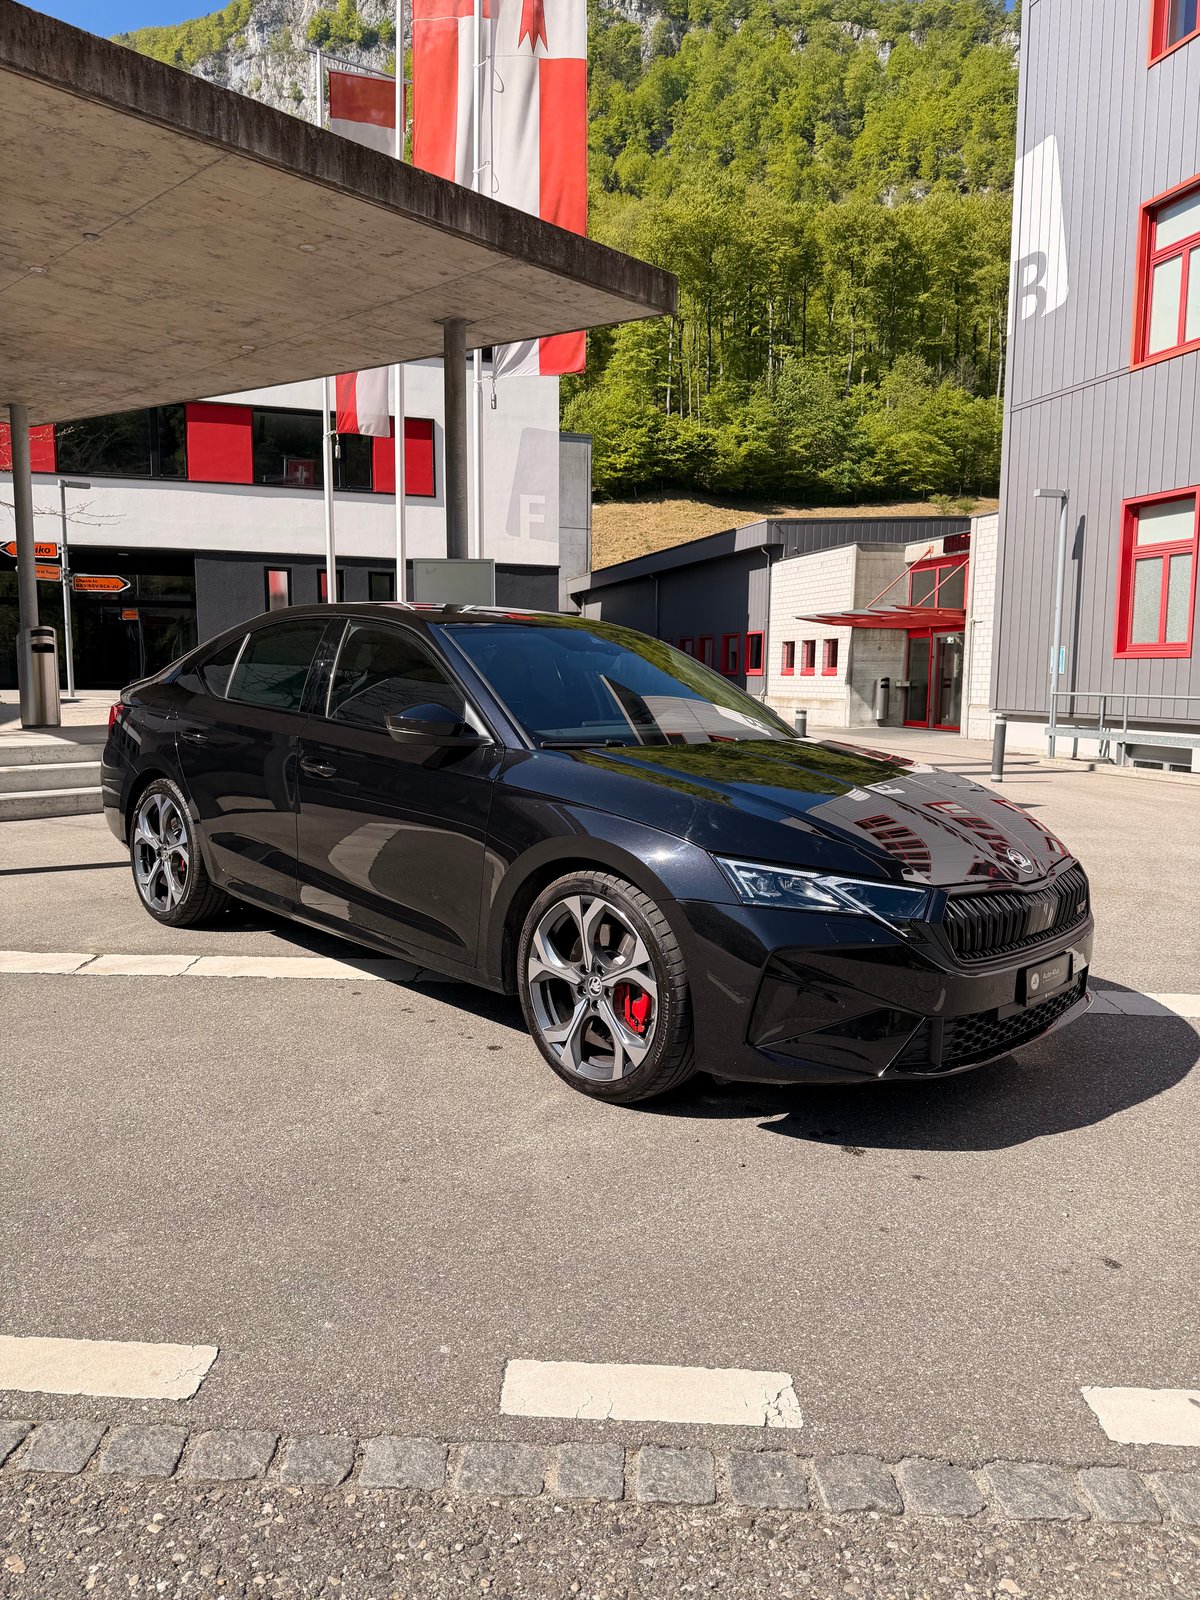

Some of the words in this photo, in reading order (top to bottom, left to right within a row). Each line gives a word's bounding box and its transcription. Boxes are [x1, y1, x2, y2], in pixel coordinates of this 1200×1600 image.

[1011, 251, 1046, 326] B
[519, 494, 546, 539] F
[35, 545, 51, 554] iko
